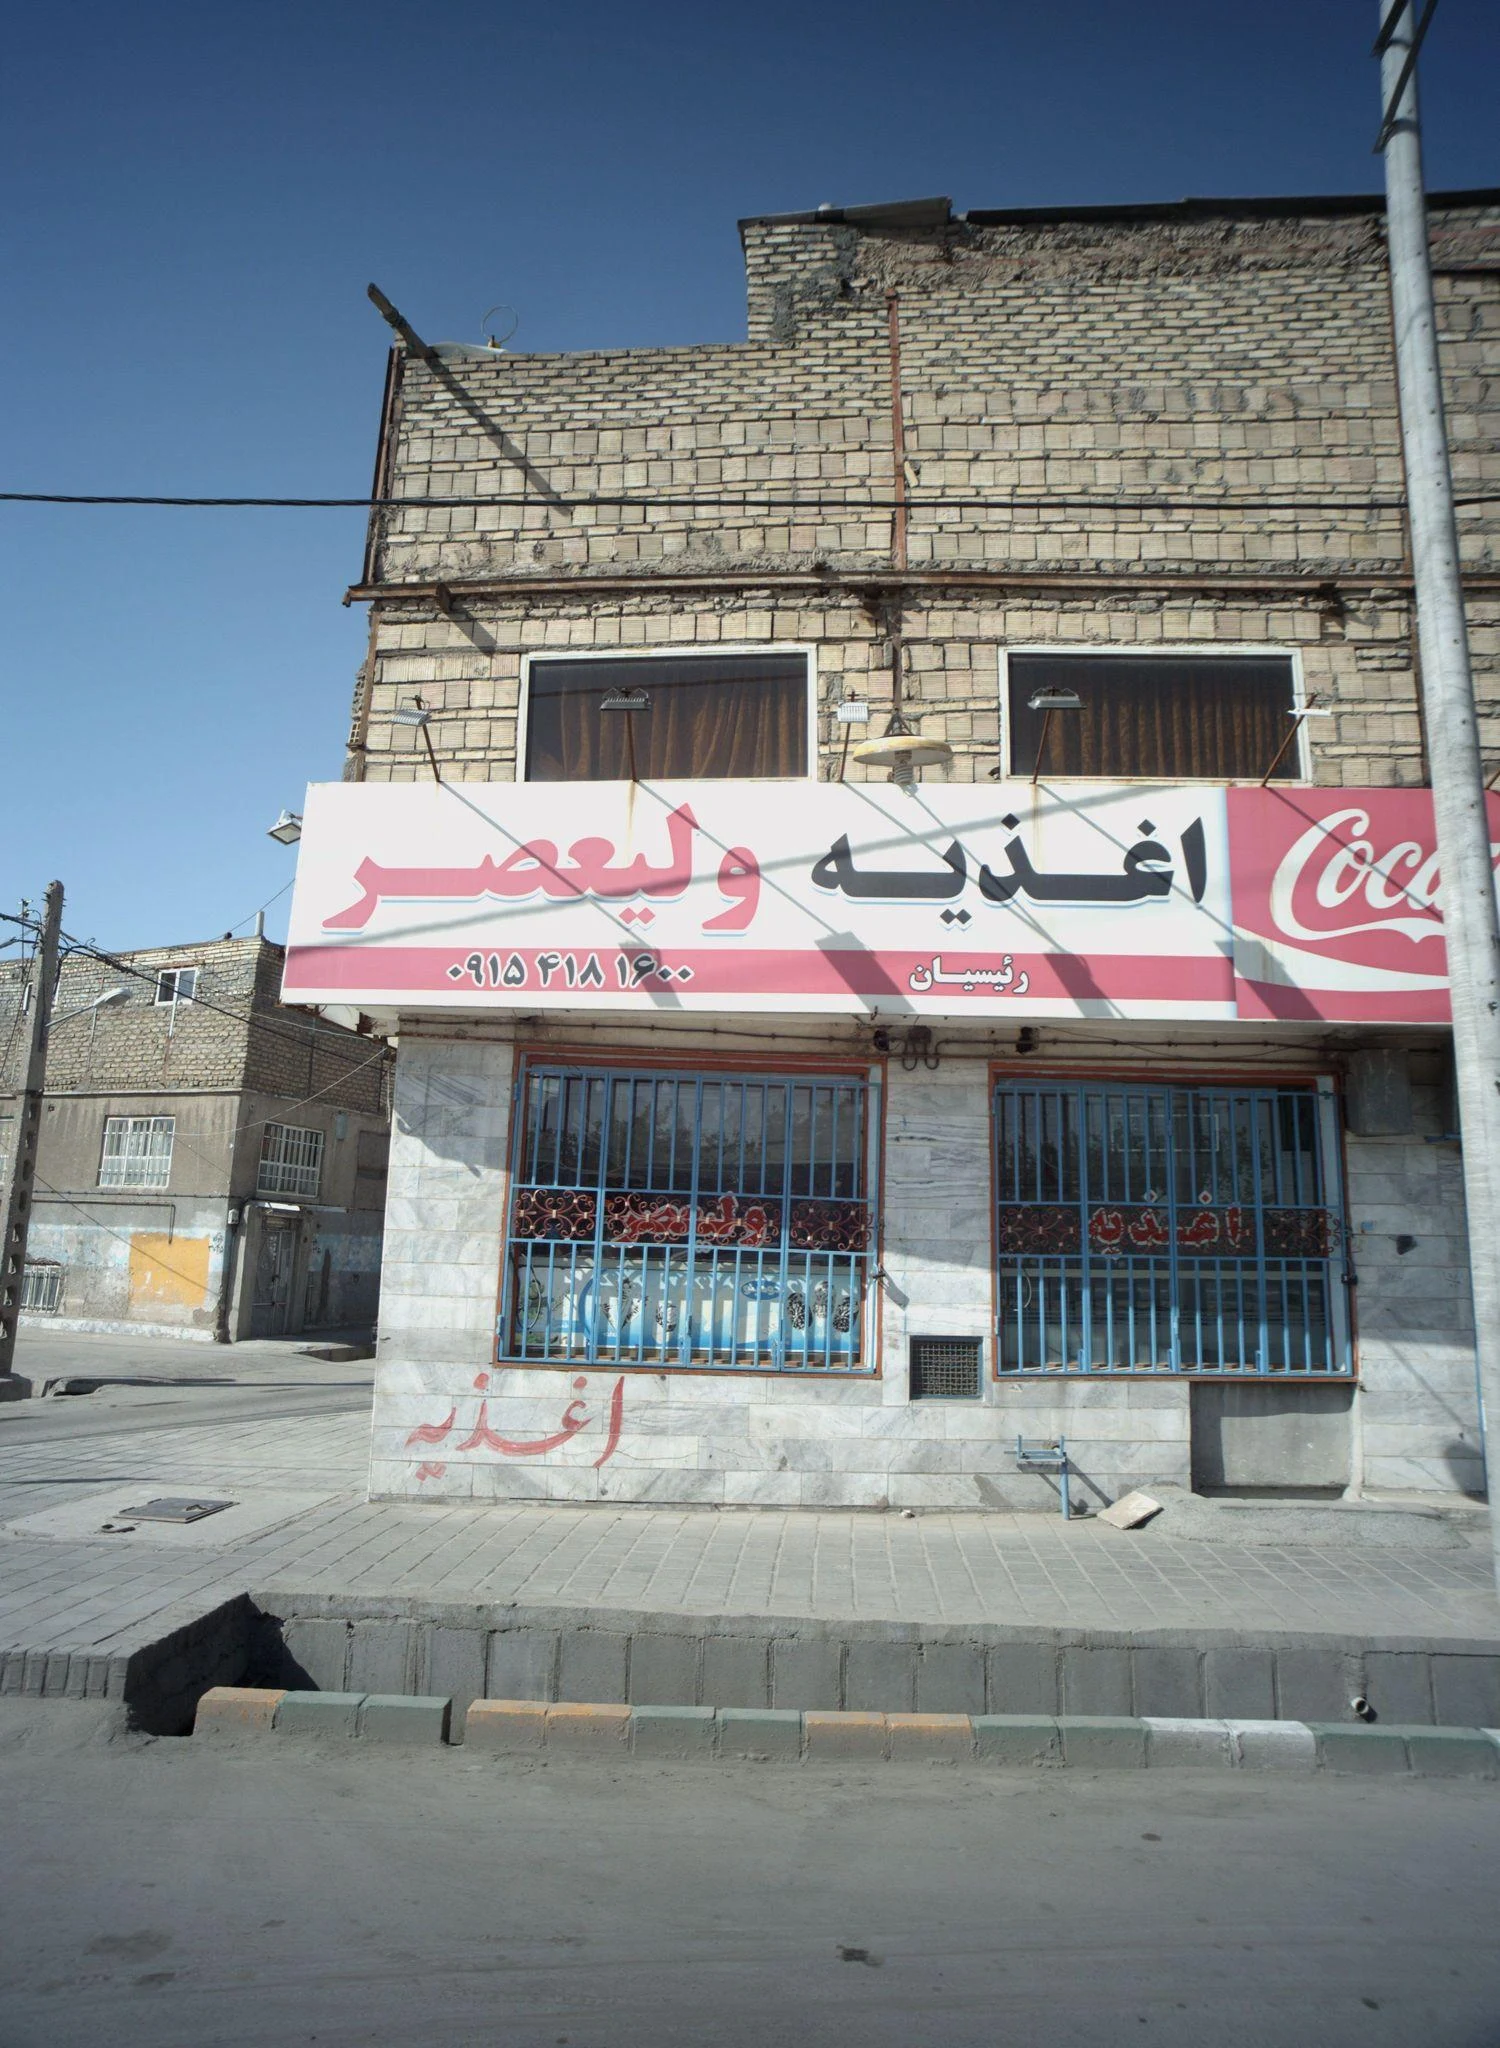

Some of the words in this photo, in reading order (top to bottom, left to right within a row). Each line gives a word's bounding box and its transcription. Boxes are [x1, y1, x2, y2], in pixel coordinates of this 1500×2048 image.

[811, 813, 1208, 929] اغذیه
[446, 952, 527, 988] ۰۹۱۵
[535, 952, 605, 988] ۴۱۸
[614, 952, 695, 988] ۱۶۰۰
[909, 954, 1029, 994] رئیسیان
